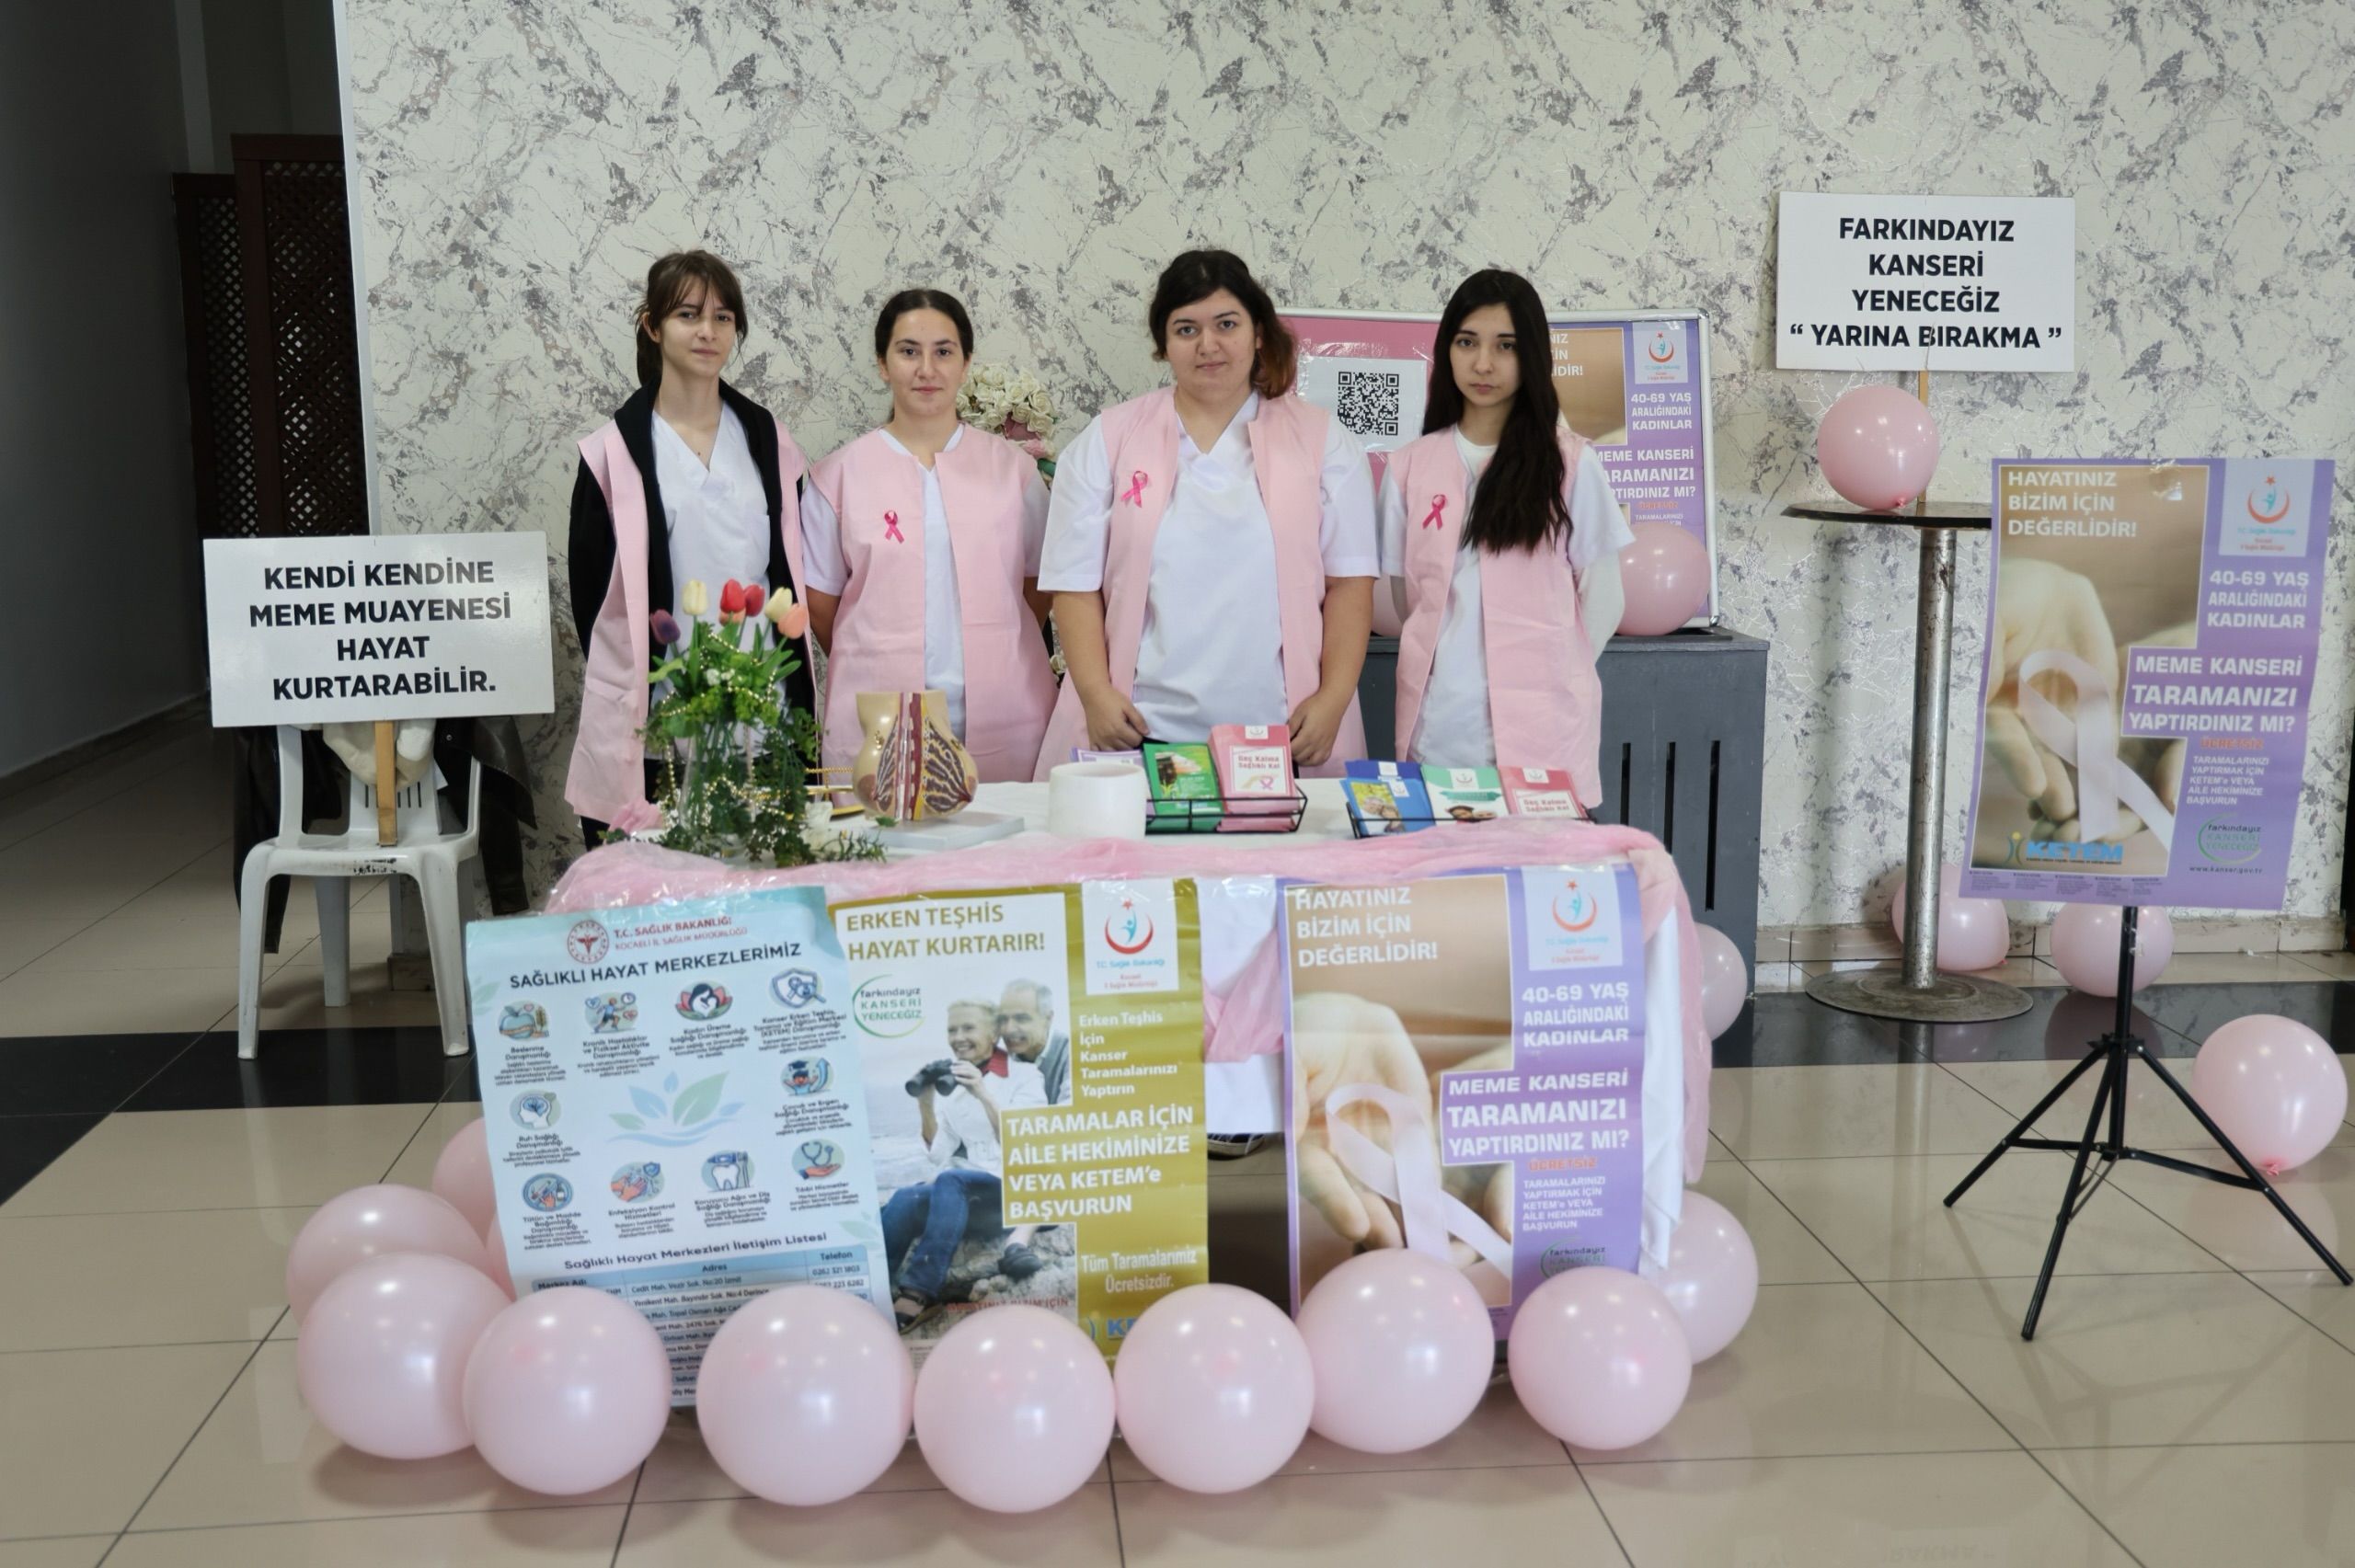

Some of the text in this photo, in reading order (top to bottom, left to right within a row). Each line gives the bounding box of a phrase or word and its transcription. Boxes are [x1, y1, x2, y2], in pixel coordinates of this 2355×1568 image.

[1840, 218, 2014, 241] FARKINDAYIZ
[1869, 251, 1982, 277] KANSERİ
[1853, 286, 2000, 312] YENECEĞİZ
[1811, 325, 1910, 347] YARINA
[1919, 326, 2040, 348] BIRAKMA
[1631, 393, 1691, 405] 40-69 YAŞ
[1632, 404, 1691, 417] ARALIĞINDAKİ
[1633, 420, 1692, 430] KADINLAR
[1637, 446, 1694, 461] KANSERİ
[2008, 472, 2117, 487] HAYATINIZ
[1674, 486, 1695, 497] MI?
[2008, 495, 2114, 514] BİZİM İÇİN
[2008, 516, 2136, 537] DEĞERLİDİR!
[265, 557, 494, 589] KENDİ KENDİNE
[2210, 571, 2309, 589] 40-69 YAŞ
[2208, 589, 2306, 608] ARALIĞINDAKİ
[250, 592, 511, 627] MEME MUAYENESİ
[2208, 612, 2304, 629] KADINLAR
[338, 636, 430, 660] HAYAT
[2136, 655, 2302, 676] MEME KANSERİ
[273, 666, 496, 700] KURTARABİLİR.
[2131, 685, 2296, 707] TARAMANIZI
[2130, 713, 2295, 733] YAPTIRDINIZ MI?
[2246, 767, 2264, 775] İÇİN
[2188, 786, 2263, 795] AİLE HEKİMİNİZE
[2187, 796, 2237, 806] BAŞVURUN
[2208, 824, 2261, 833] farkındayız
[2027, 841, 2123, 860] KETEM
[2189, 865, 2263, 874] www.kanser.gov.tr
[1295, 887, 1410, 910] HAYATINIZ
[846, 901, 1004, 932] ERKEN TEŞHİS
[615, 929, 633, 938] T.C.
[635, 922, 673, 936] SAĞLIK
[1297, 915, 1410, 939] BİZİM İÇİN
[615, 939, 650, 950] KOCAELİ
[662, 933, 692, 946] SAĞLIK
[848, 933, 1045, 960] HAYAT KURTARIR!
[1298, 943, 1438, 967] DEĞERLİDİR!
[511, 943, 802, 989] SAĞLIKLI HAYAT MERKEZLERİMİZ
[860, 987, 920, 999] farkındayız
[1522, 982, 1629, 1004] 40-69 YAŞ
[860, 998, 921, 1010] KANSERİ
[861, 1008, 920, 1022] YENECEĞİZ
[1079, 1011, 1163, 1028] Erken Teşhis
[1523, 1002, 1629, 1027] ARALIĞINDAKİ
[1079, 1032, 1104, 1047] İçin
[1523, 1028, 1628, 1047] KADINLAR
[1080, 1048, 1127, 1061] Kanser
[1080, 1063, 1178, 1078] Taramalarınızı
[1082, 1083, 1134, 1099] Yaptırın
[1449, 1068, 1628, 1095] MEME KANSERİ
[1007, 1104, 1193, 1137] TARAMALAR İÇİN
[1447, 1098, 1626, 1127] TARAMANIZI
[1008, 1135, 1189, 1165] AİLE HEKİMİNİZE
[1449, 1129, 1629, 1157] YAPTIRDINIZ MI?
[1008, 1173, 1064, 1192] VEYA
[1523, 1176, 1605, 1189] TARAMALARINIZI
[1523, 1186, 1602, 1200] YAPTIRMAK İÇİN
[1009, 1196, 1132, 1221] BAŞVURUN
[1568, 1199, 1593, 1207] VEYA
[1523, 1207, 1603, 1220] AİLE HEKİMİNİZE
[1523, 1220, 1577, 1232] BAŞVURUN
[565, 1231, 827, 1269] Sağlıklı Hayat Merkezleri İletişim Listesi
[821, 1252, 853, 1261] Telefon
[1549, 1247, 1605, 1255] farkındayız
[1082, 1248, 1197, 1272] Tüm Taramalarımız
[1106, 1275, 1173, 1293] Ücretsizdir.
